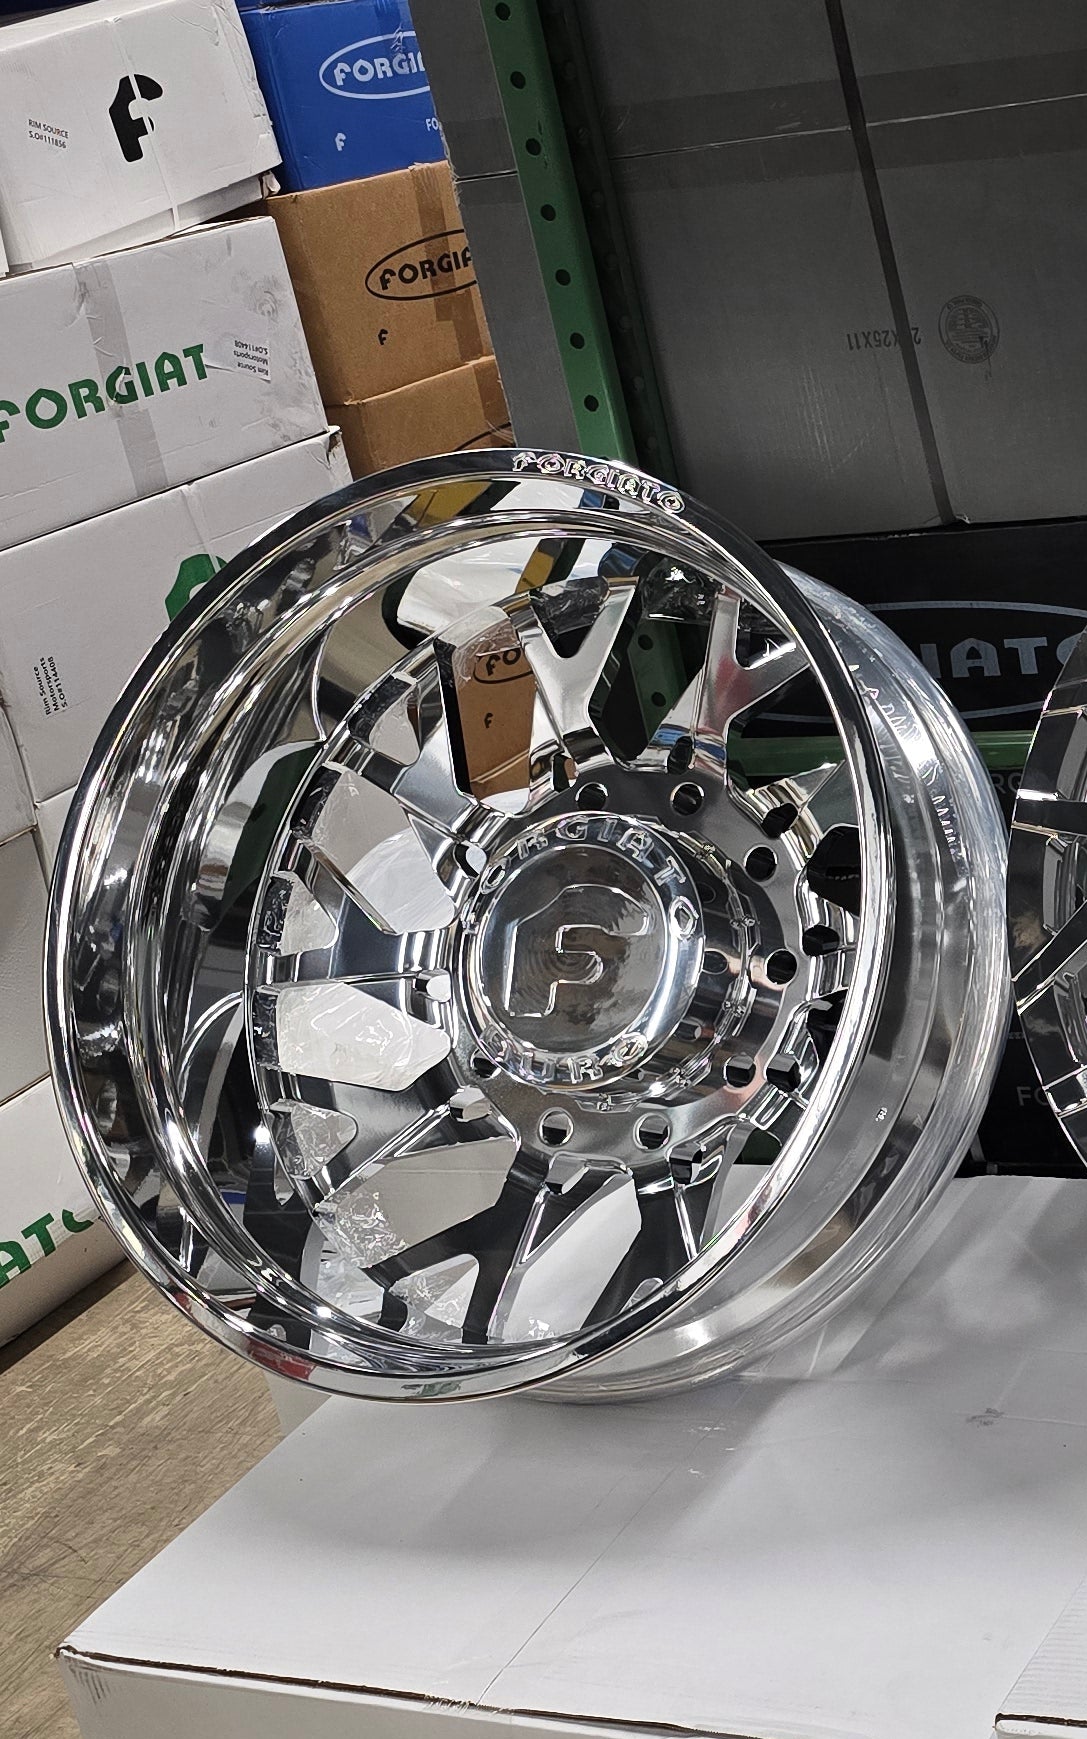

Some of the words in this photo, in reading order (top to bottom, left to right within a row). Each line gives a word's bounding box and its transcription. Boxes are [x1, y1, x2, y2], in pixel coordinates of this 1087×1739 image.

[43, 123, 69, 139] SOURCE
[847, 327, 922, 351] 2X25X11
[512, 451, 686, 515] FORGIATO
